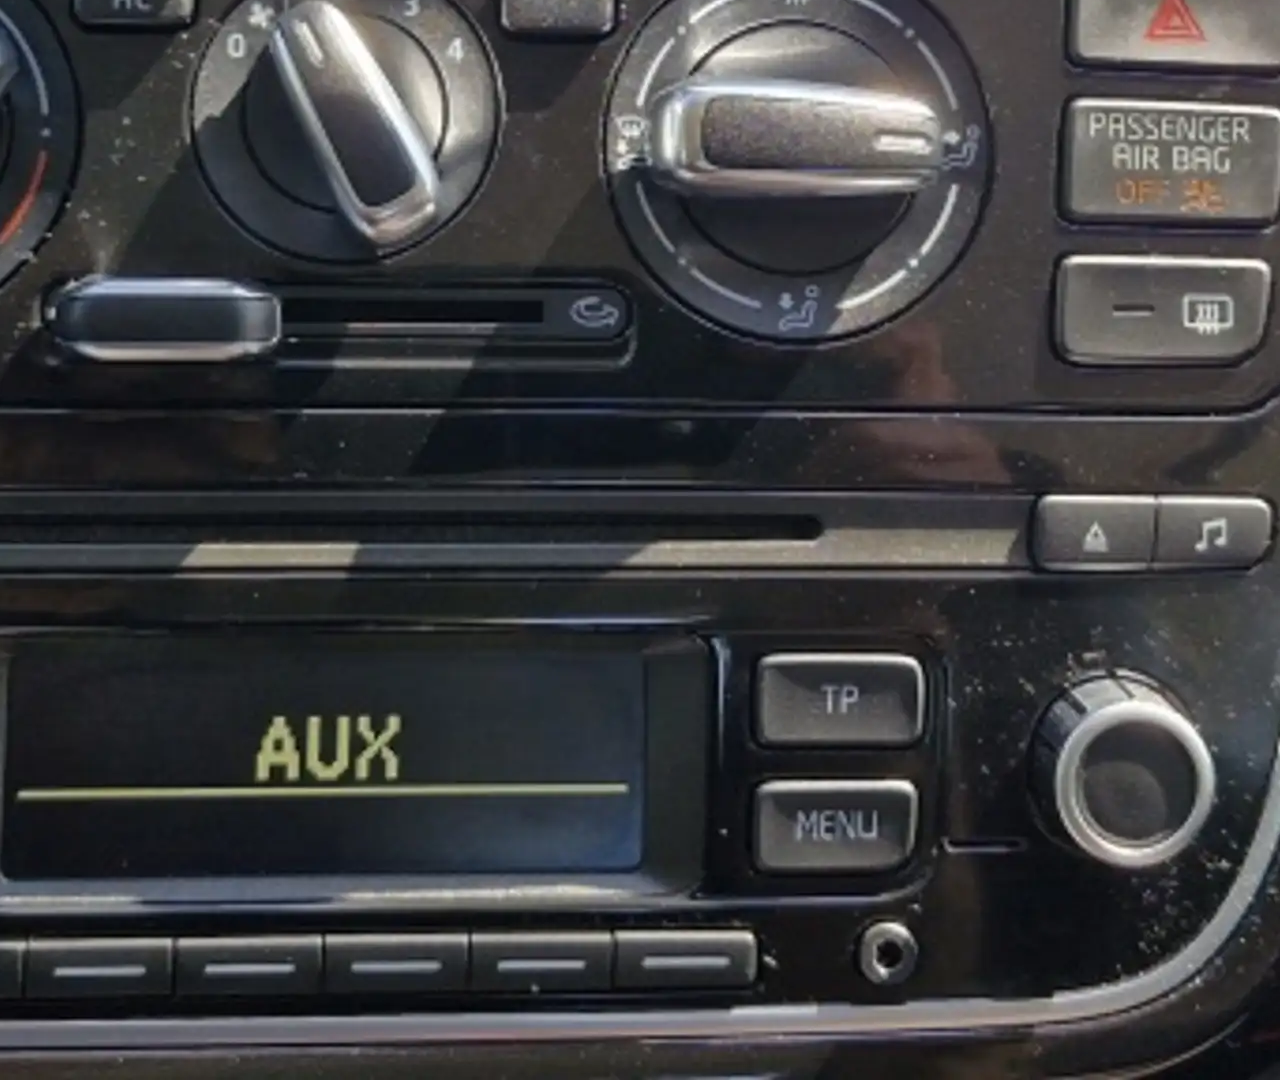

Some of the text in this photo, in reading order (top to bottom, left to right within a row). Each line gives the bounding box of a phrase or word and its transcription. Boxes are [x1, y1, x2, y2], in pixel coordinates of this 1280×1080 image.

[226, 34, 245, 58] 0
[446, 37, 465, 62] 4
[1089, 112, 1251, 142] PASSENGER
[1112, 144, 1231, 173] AIR BAG
[821, 686, 859, 714] TP
[255, 715, 401, 782] AUX
[796, 811, 879, 841] MENU
